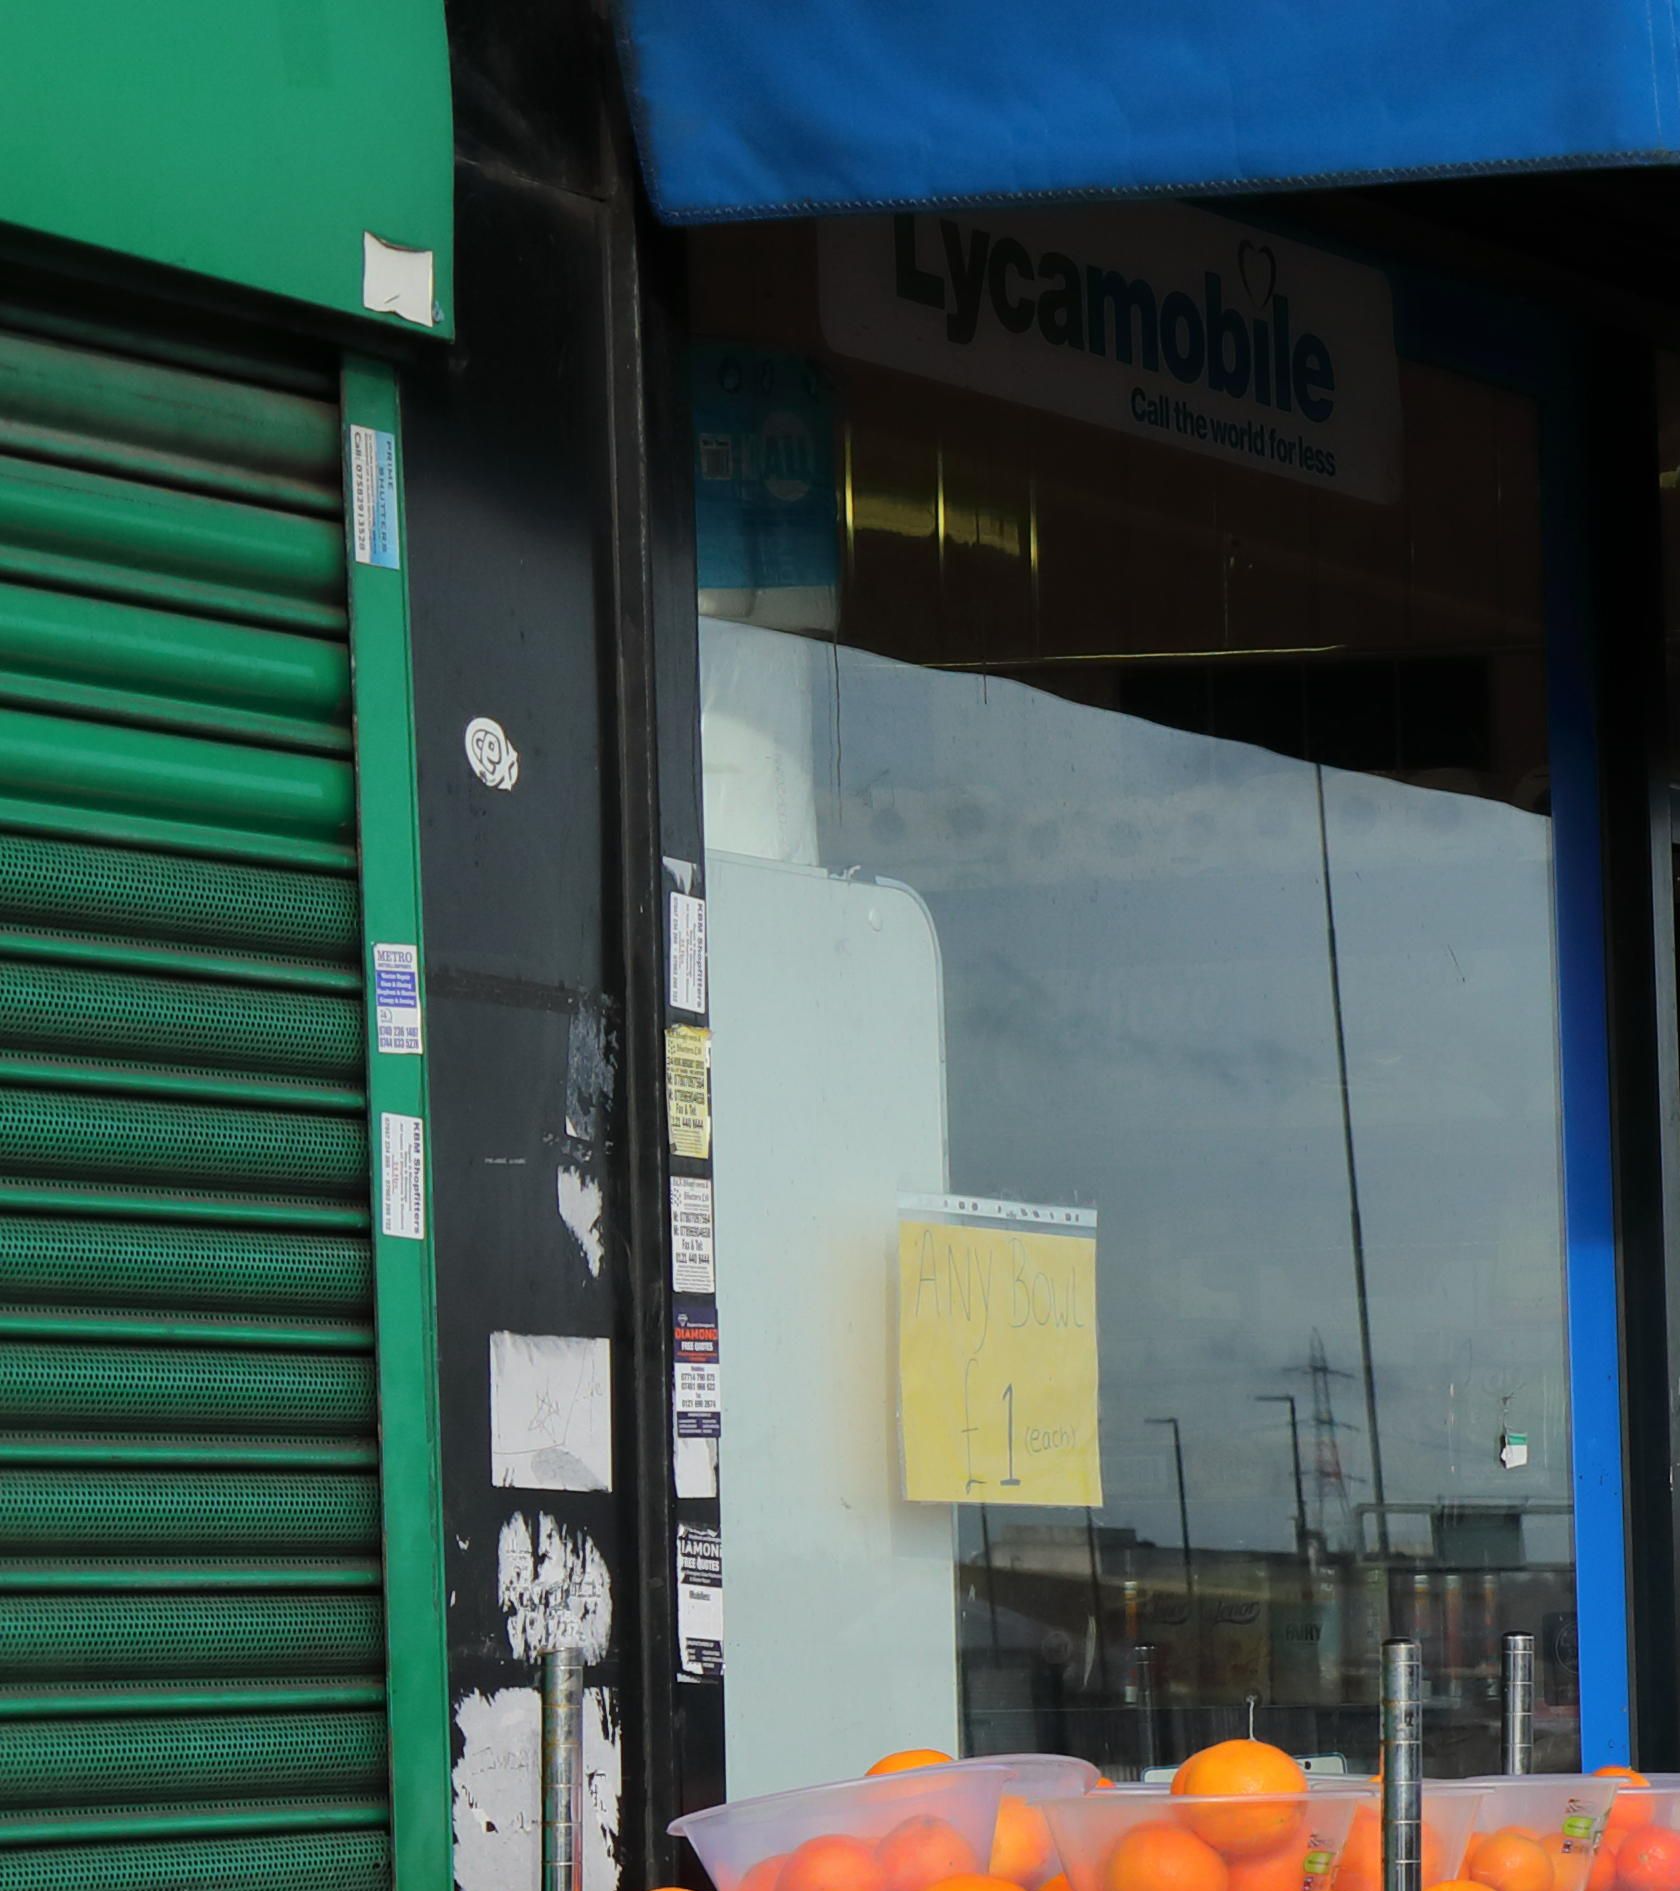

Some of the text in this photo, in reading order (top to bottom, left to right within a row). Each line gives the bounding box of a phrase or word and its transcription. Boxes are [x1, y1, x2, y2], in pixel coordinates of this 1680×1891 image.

[894, 212, 1335, 423] Lycamobile
[1131, 386, 1335, 477] Call the world for less
[377, 950, 412, 963] METRO
[675, 1328, 718, 1340] DIAMOND
